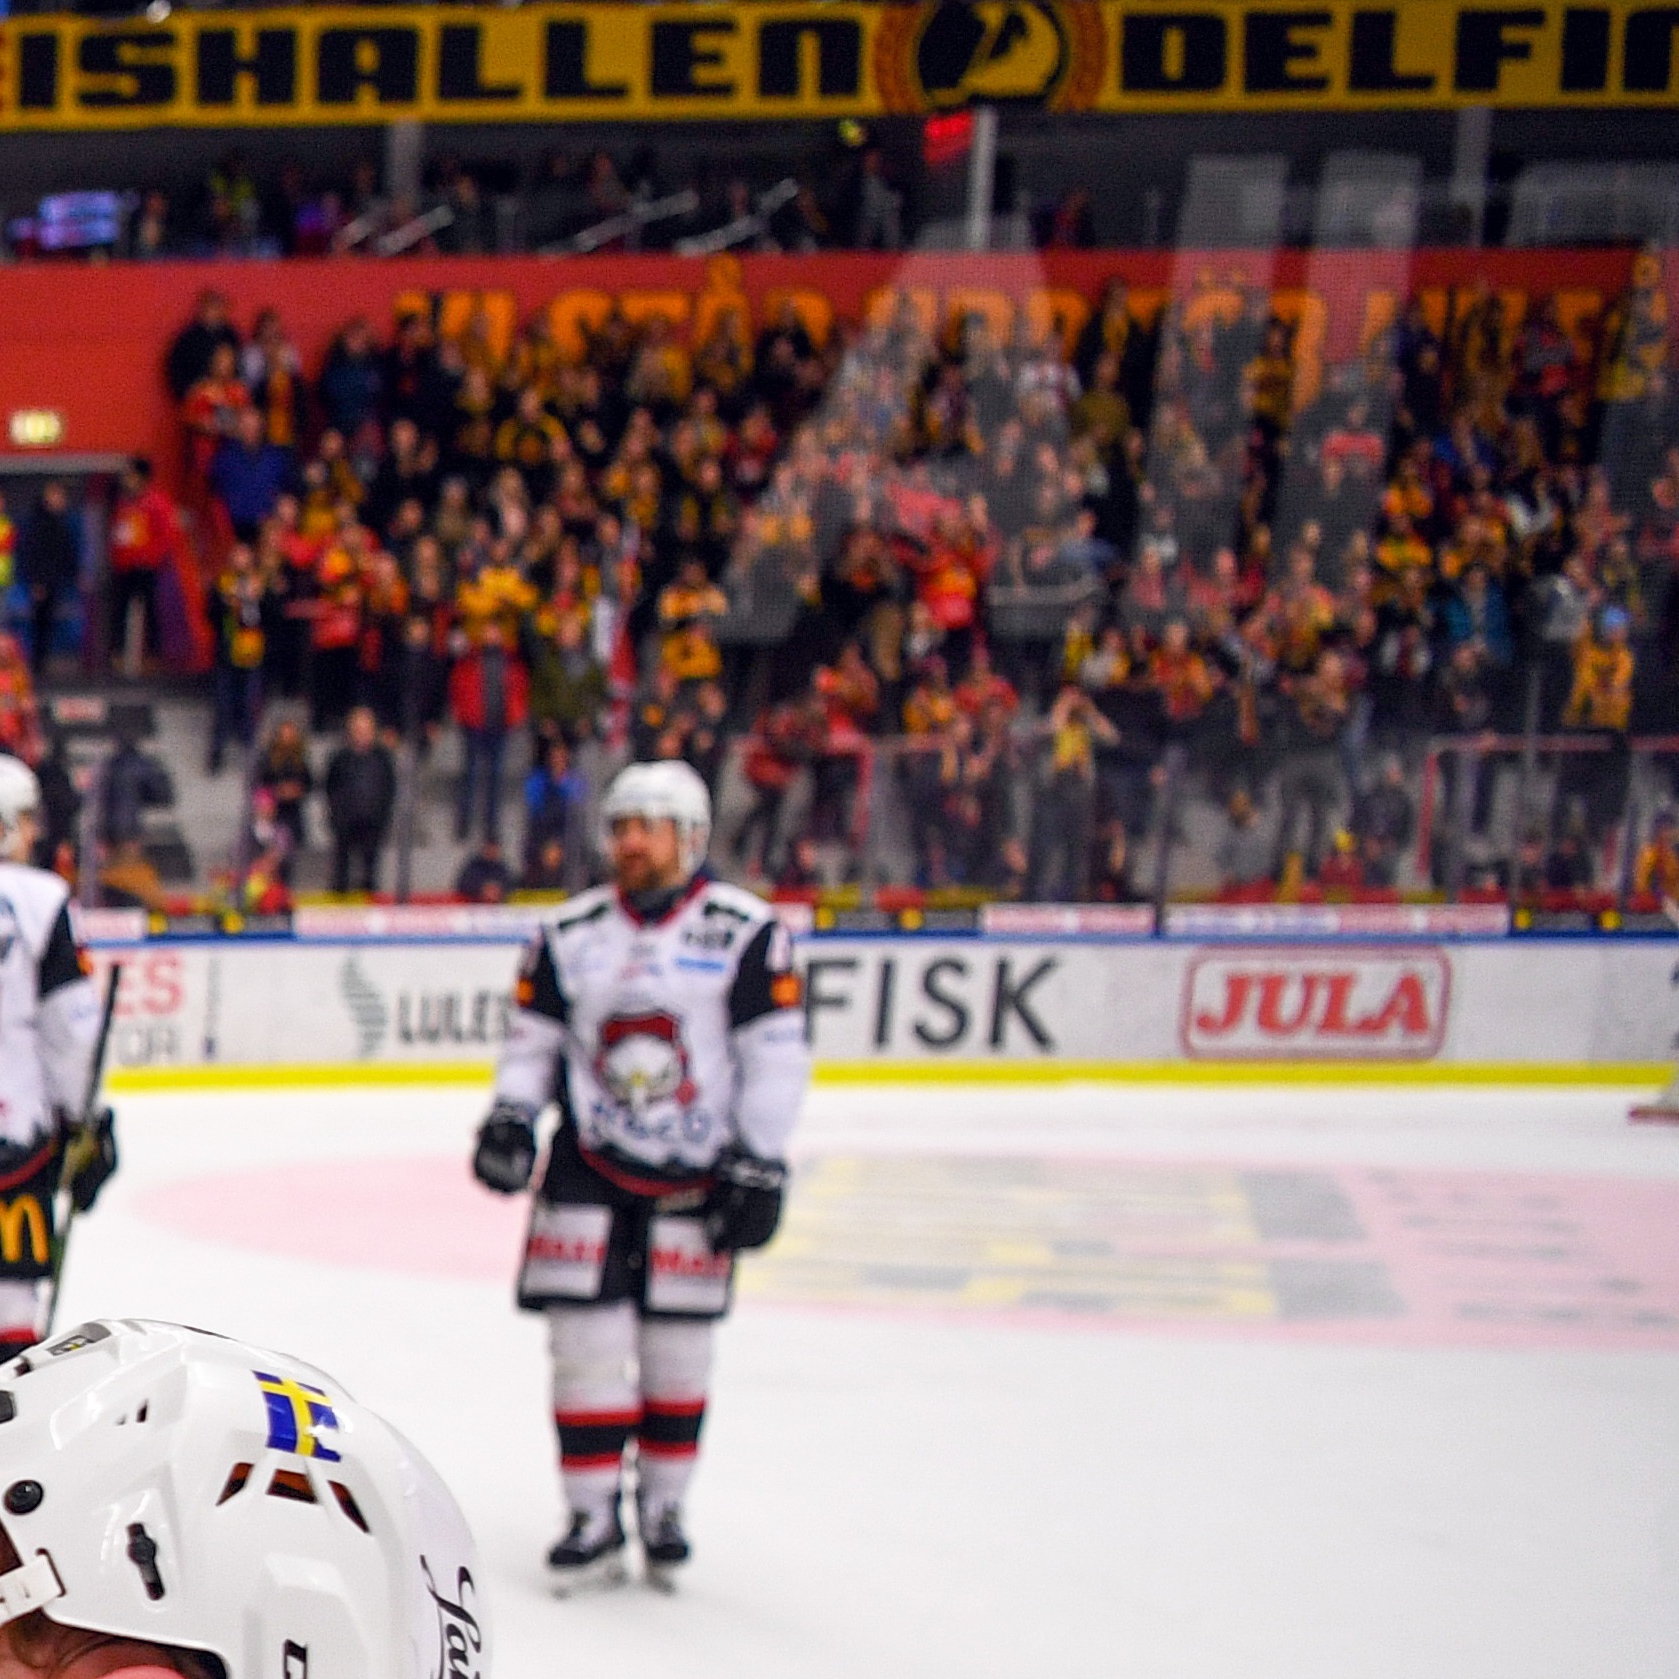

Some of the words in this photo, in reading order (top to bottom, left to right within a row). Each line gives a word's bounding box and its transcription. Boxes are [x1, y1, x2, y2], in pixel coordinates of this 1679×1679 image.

[19, 20, 862, 110] ISHALLEN
[806, 956, 1065, 1053] FISK
[1196, 970, 1434, 1040] JULA
